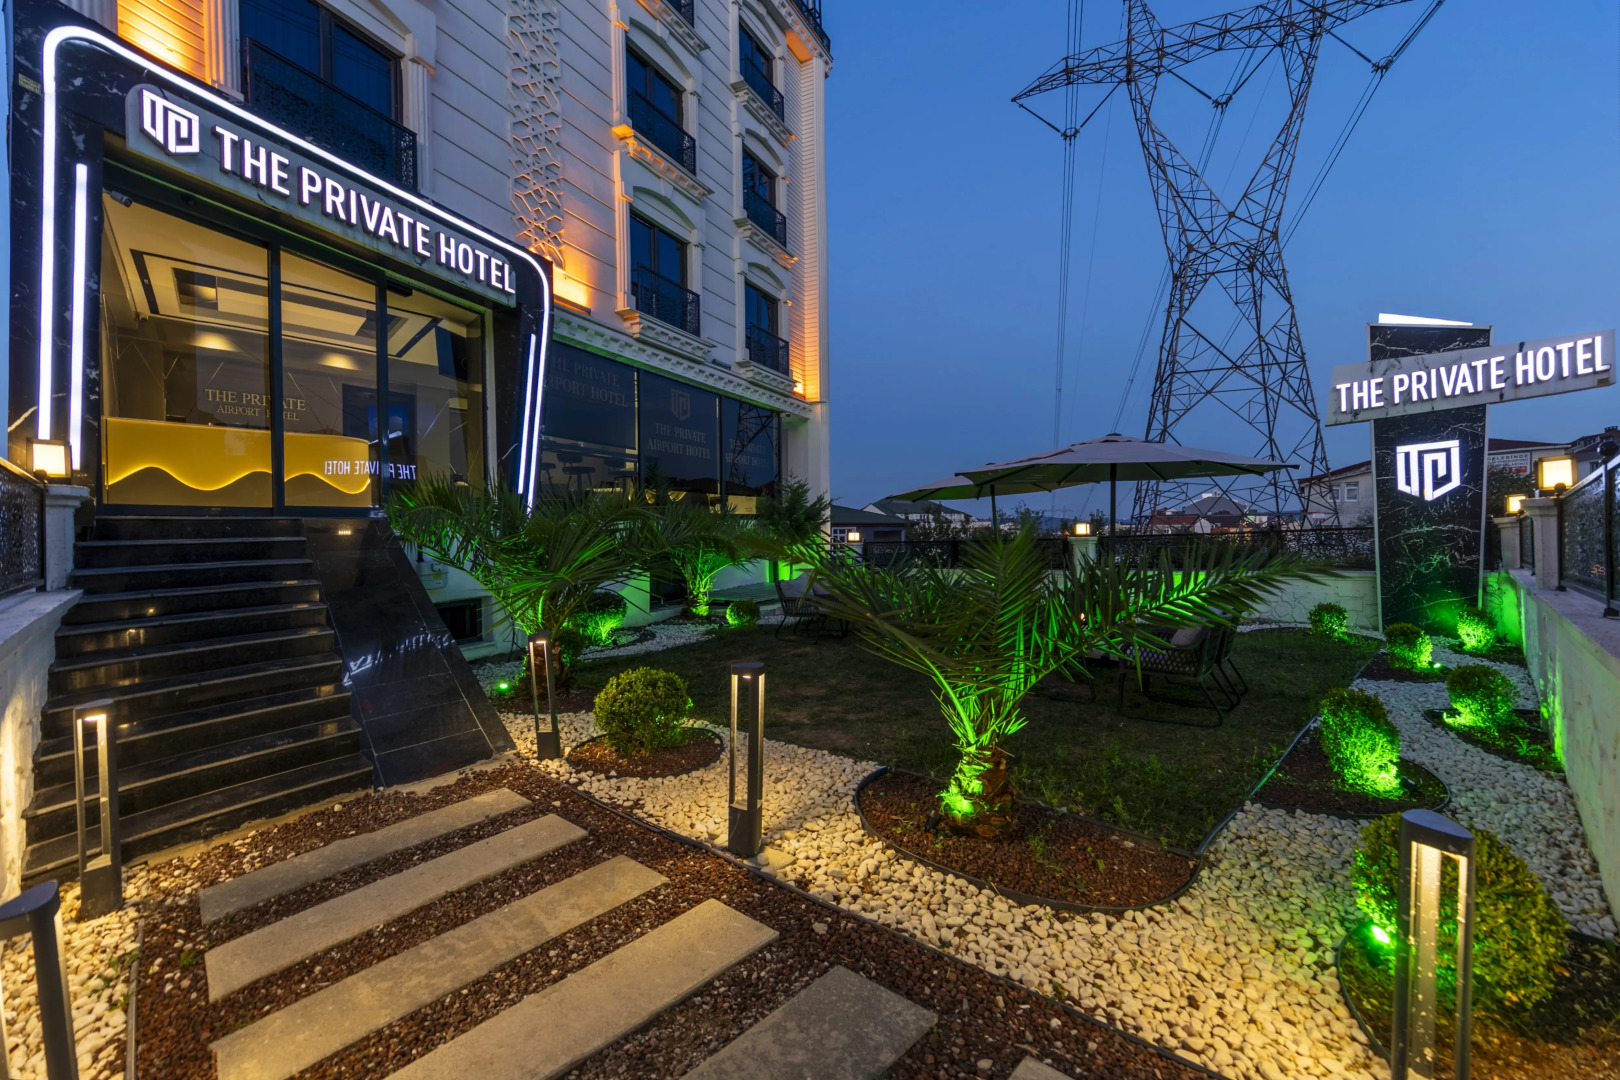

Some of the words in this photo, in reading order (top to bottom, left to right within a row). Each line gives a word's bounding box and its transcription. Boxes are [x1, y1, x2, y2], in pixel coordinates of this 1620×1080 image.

[214, 125, 290, 196] THE
[302, 166, 431, 258] PRIVATE
[439, 232, 516, 294] HOTEL
[1336, 377, 1384, 412] THE
[1393, 356, 1505, 404] PRIVATE
[1516, 336, 1611, 386] HOTEL
[205, 388, 237, 403] THE
[242, 392, 306, 411] PRIATE
[591, 386, 628, 408] HOTEL
[216, 404, 260, 417] AIRPORT
[266, 409, 300, 420] HTEL
[654, 422, 672, 437] THE
[674, 426, 706, 444] PRIVATE
[648, 438, 684, 454] AIRPORT
[686, 445, 711, 460] HOTEL
